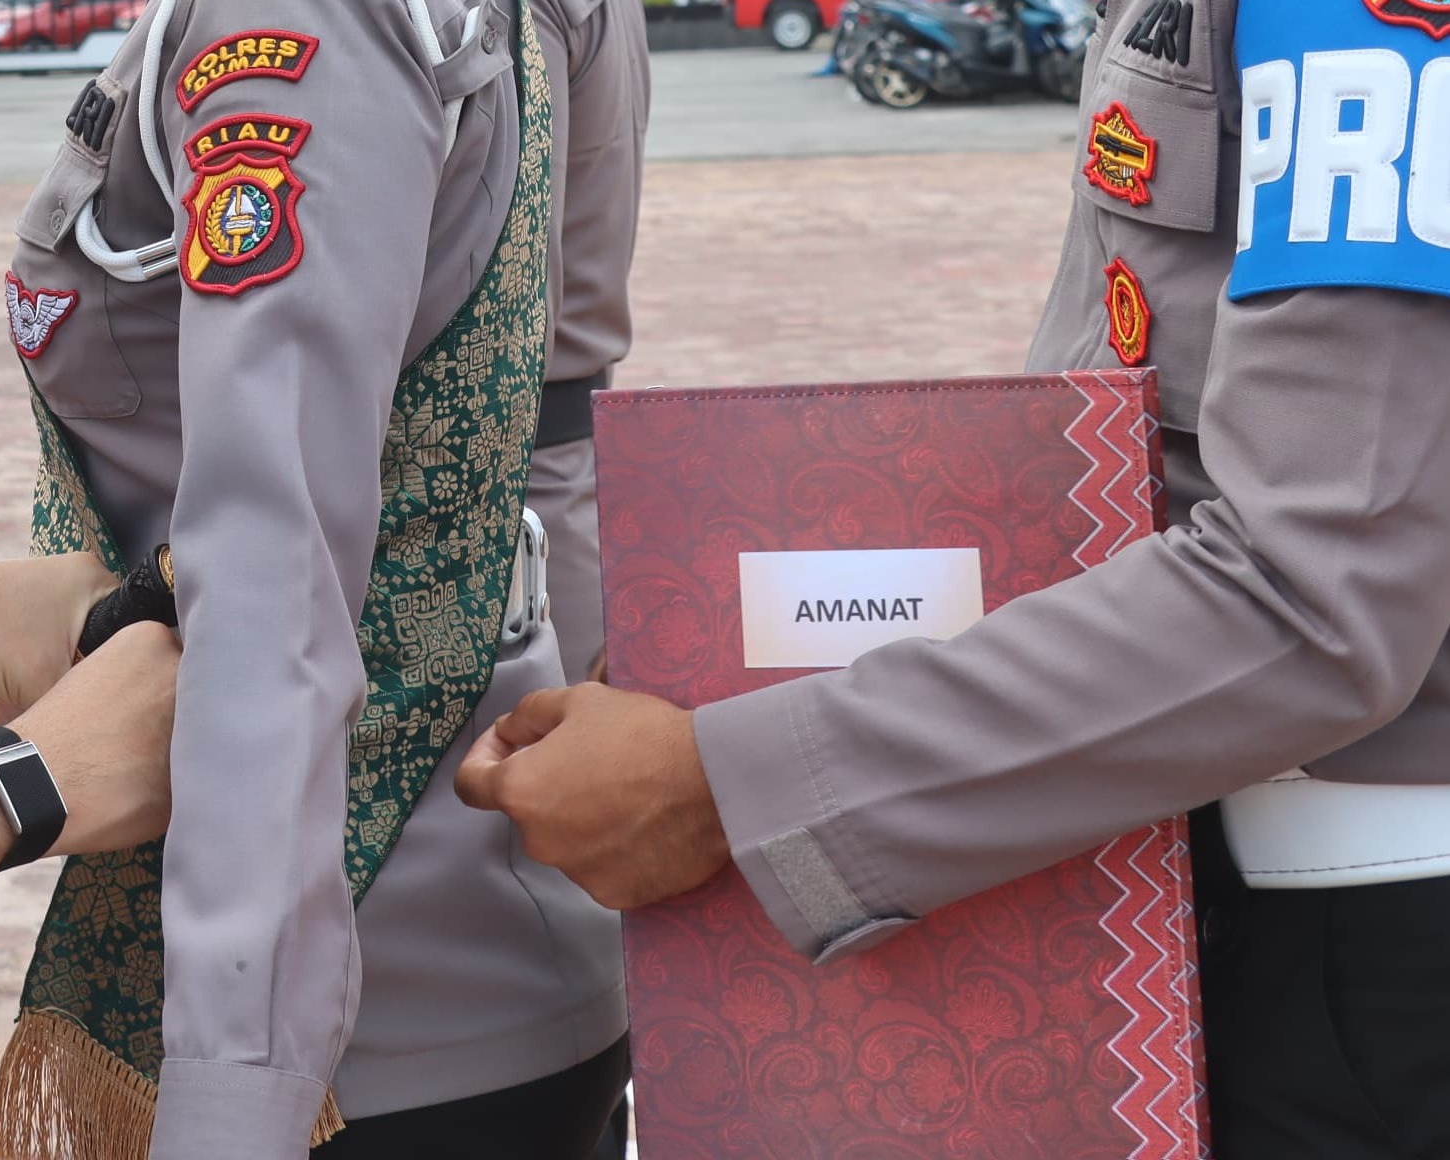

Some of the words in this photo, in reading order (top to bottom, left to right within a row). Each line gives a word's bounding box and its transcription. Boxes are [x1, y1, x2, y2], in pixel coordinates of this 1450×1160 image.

[183, 38, 299, 92] POLRES
[193, 54, 283, 93] DUMAI
[196, 122, 291, 155] RIAU
[795, 598, 923, 623] AMANAT
